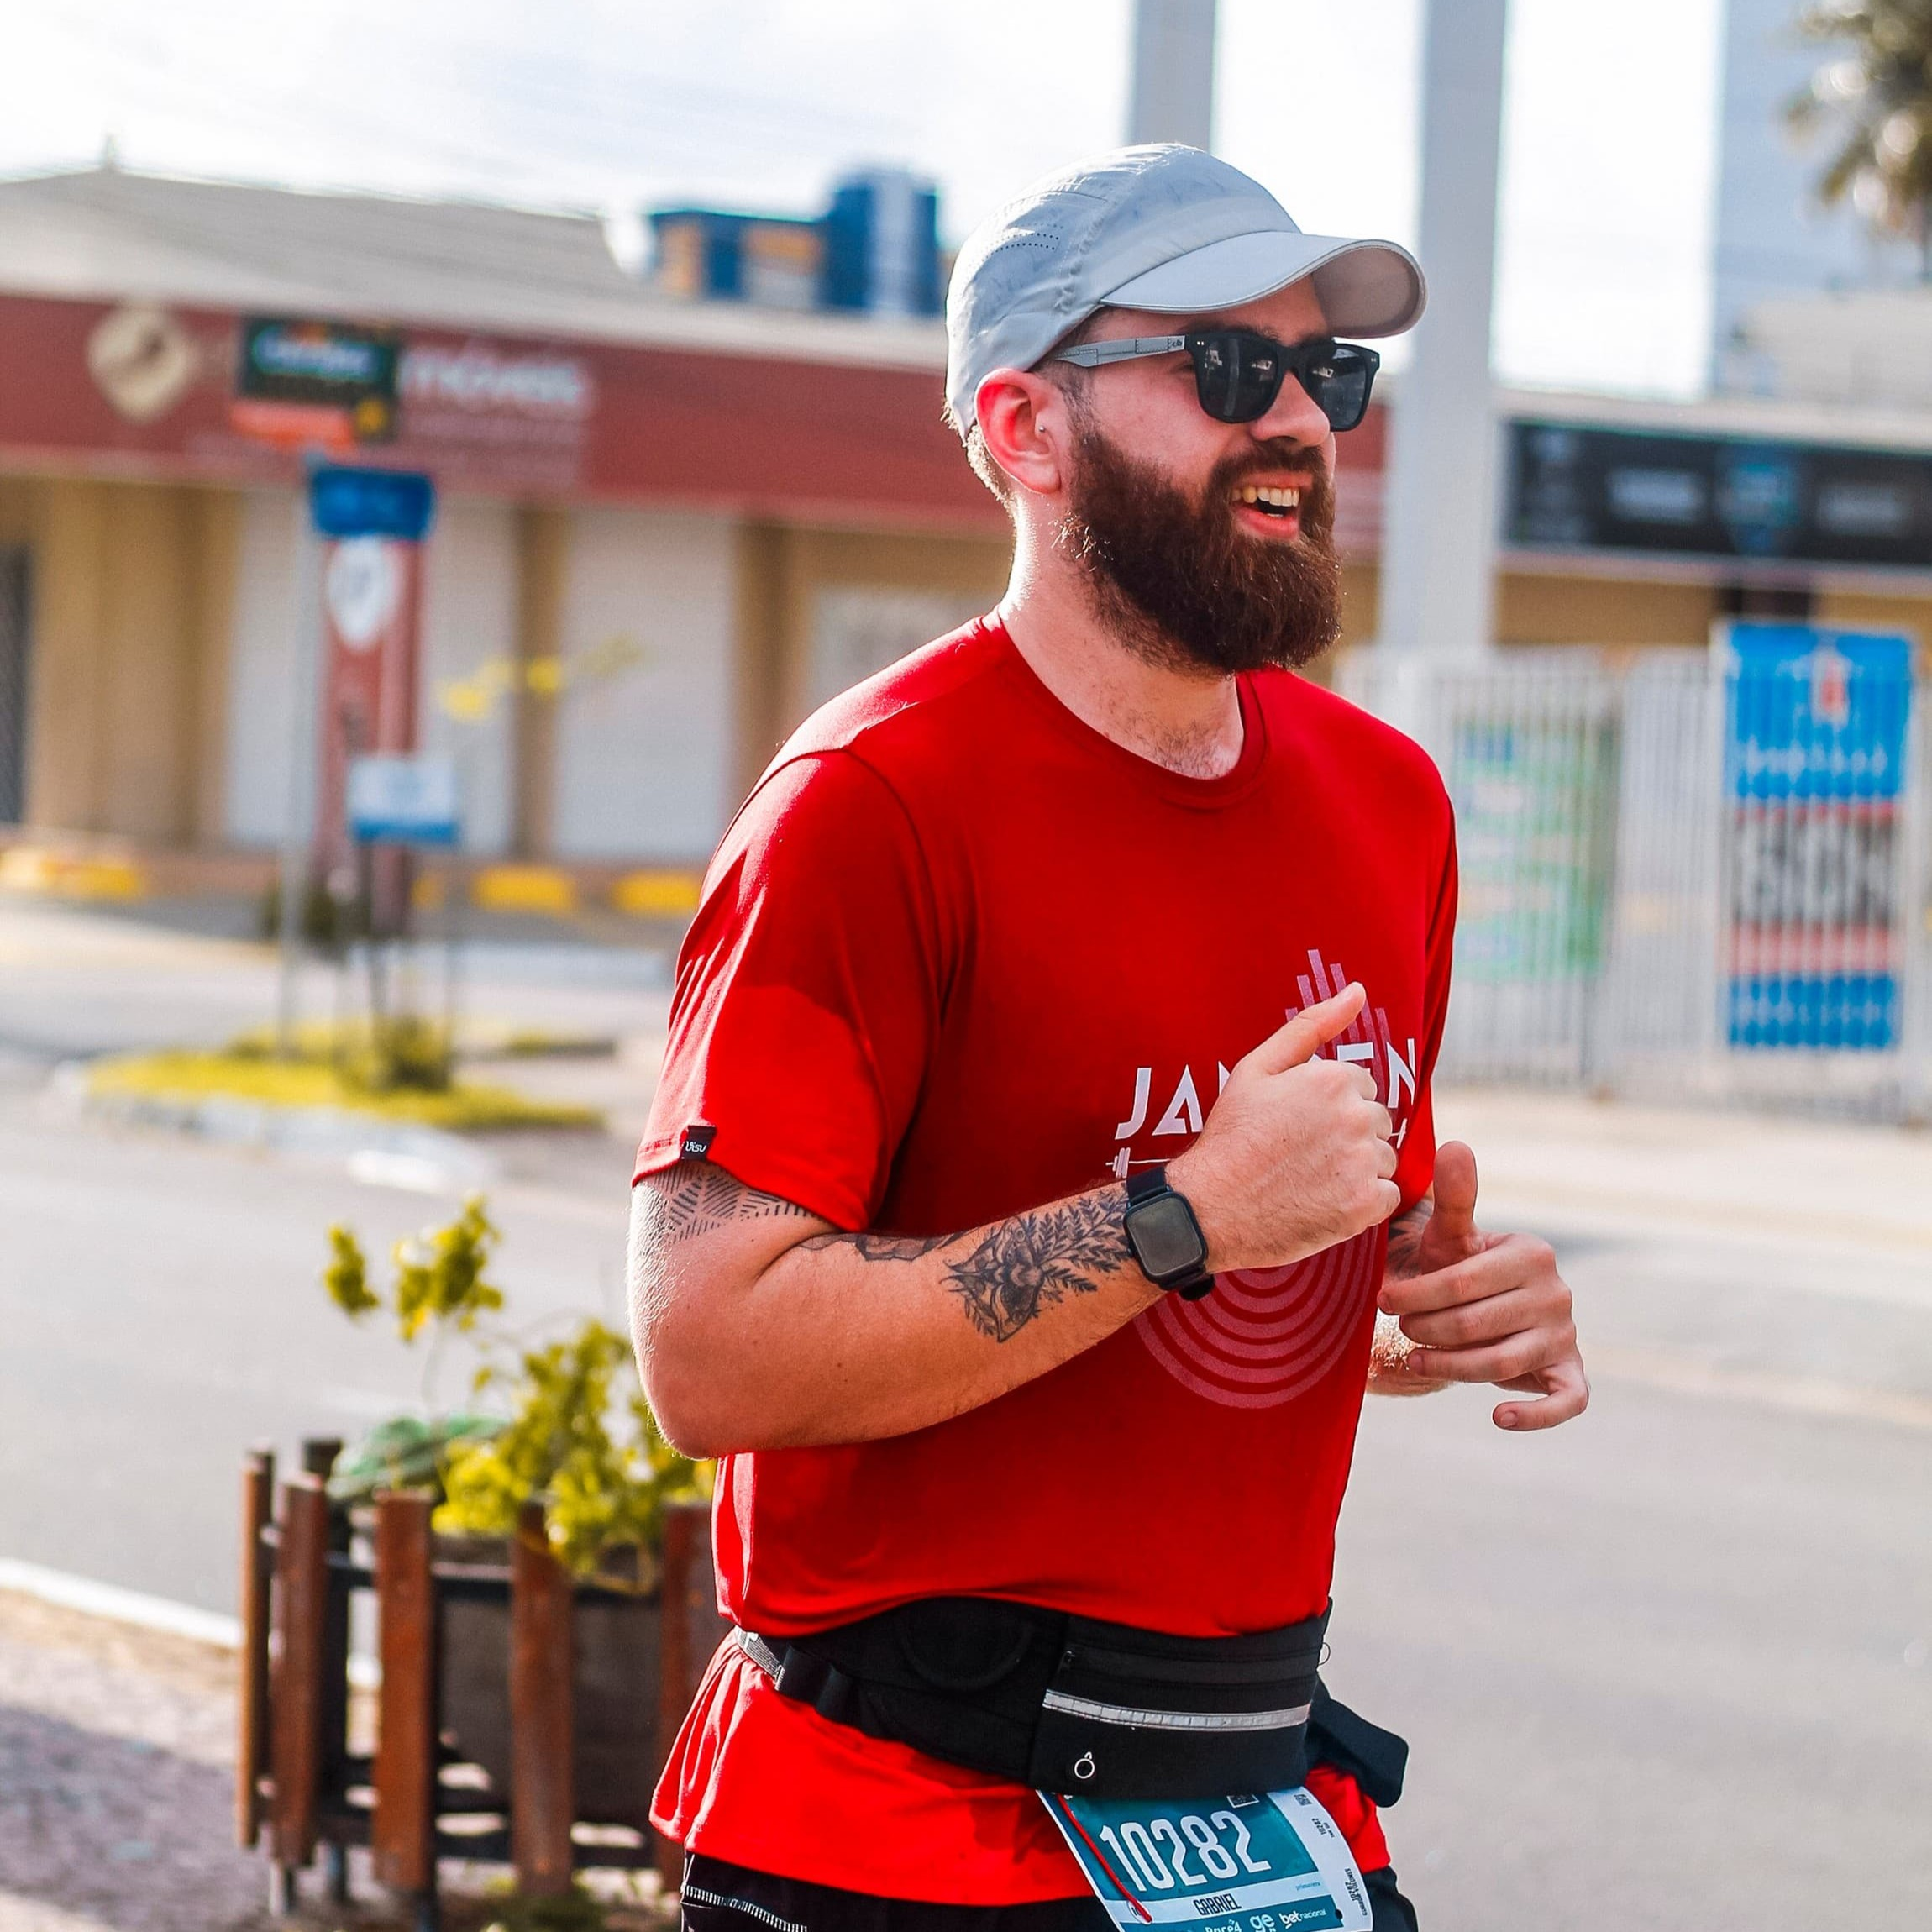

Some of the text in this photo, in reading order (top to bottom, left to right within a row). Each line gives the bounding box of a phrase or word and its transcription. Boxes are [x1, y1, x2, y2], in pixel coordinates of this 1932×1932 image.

[1115, 1037, 1416, 1140] JAN
[1099, 1810, 1272, 1893] 10282
[1193, 1893, 1242, 1916] GABRIEL
